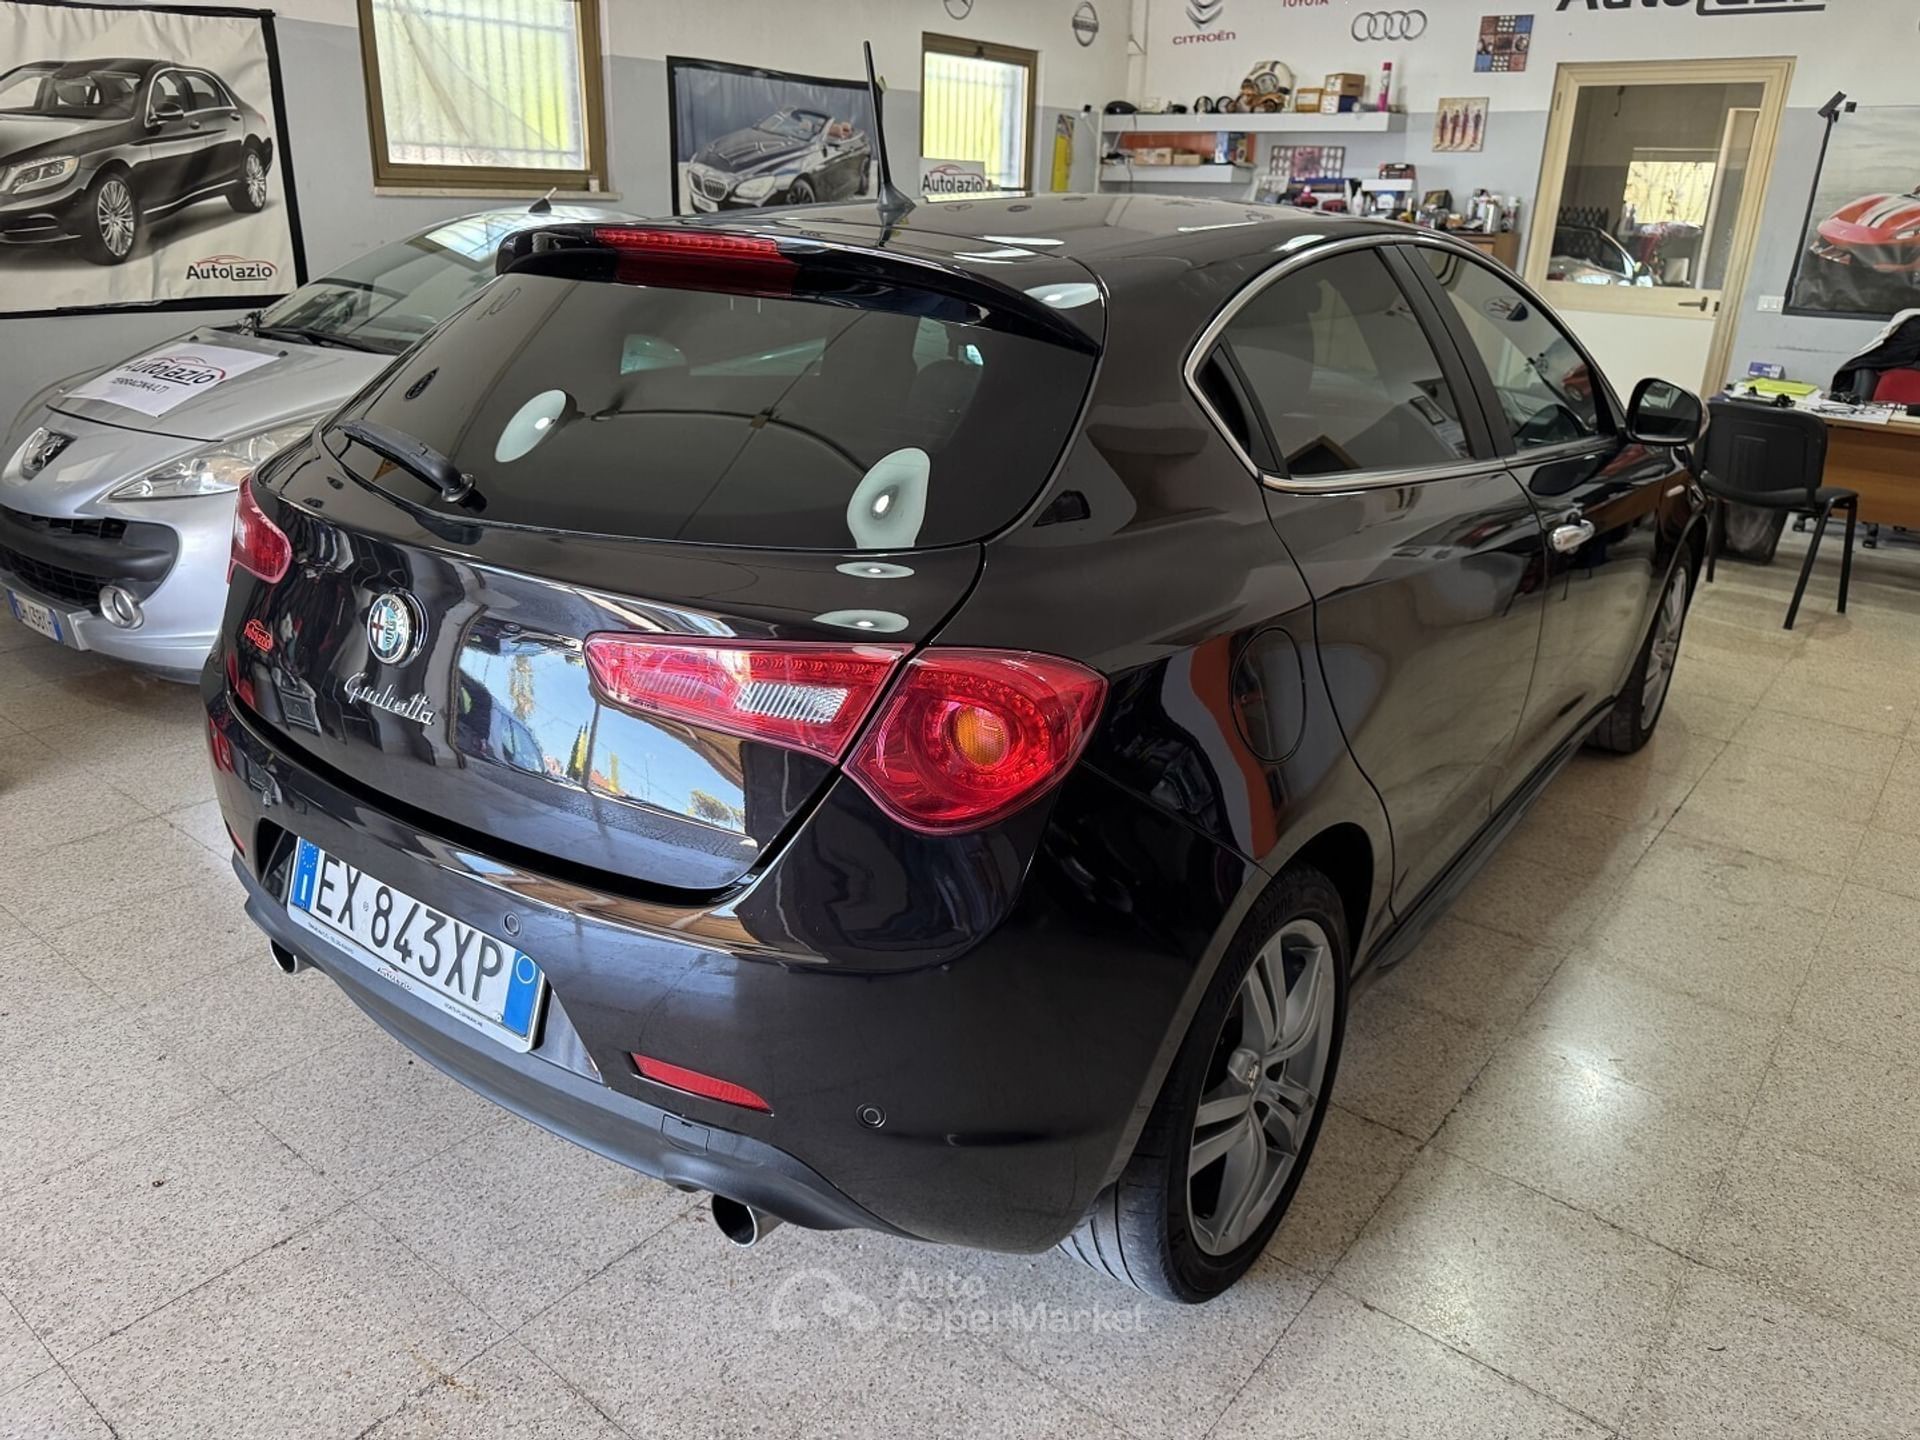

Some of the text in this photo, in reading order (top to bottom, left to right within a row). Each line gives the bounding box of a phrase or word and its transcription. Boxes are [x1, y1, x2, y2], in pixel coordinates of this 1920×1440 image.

[344, 672, 435, 726] Giulietta
[316, 852, 504, 1002] EX 843XP
